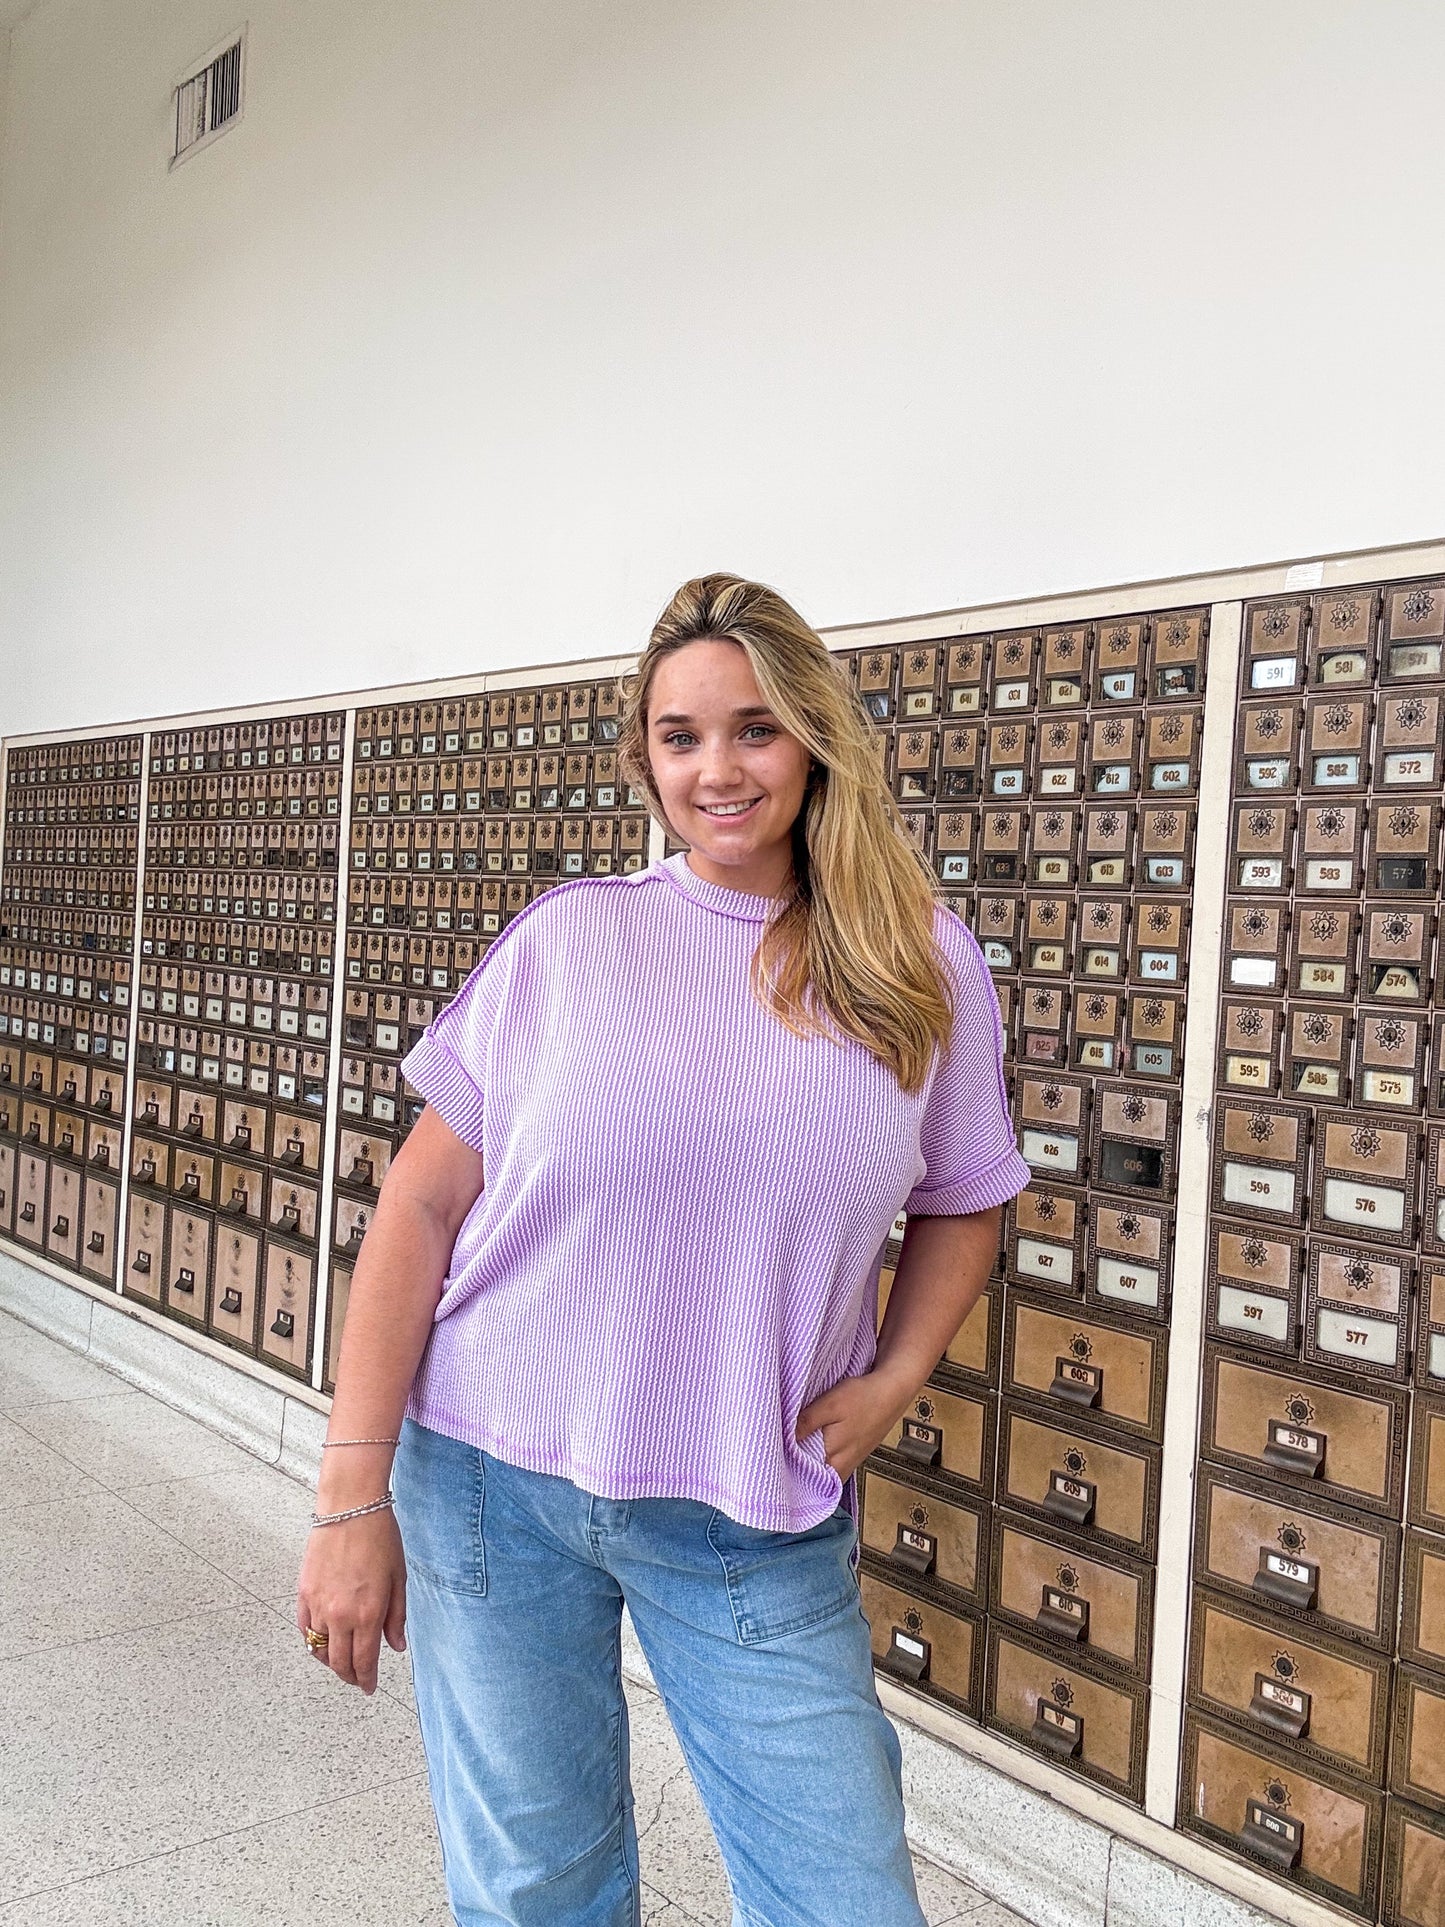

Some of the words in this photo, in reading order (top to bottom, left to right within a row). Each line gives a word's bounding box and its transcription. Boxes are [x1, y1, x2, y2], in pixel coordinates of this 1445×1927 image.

[1266, 667, 1284, 679] 591
[1335, 661, 1353, 673] 581
[1113, 680, 1125, 692] 611
[914, 698, 927, 708] 651
[1258, 767, 1277, 780] 592
[1399, 760, 1421, 774] 572
[1001, 777, 1015, 787] 632
[1051, 774, 1067, 785] 622
[1105, 773, 1120, 784] 612
[1162, 770, 1181, 782] 602
[948, 863, 963, 873] 643
[1100, 864, 1115, 875] 613
[1155, 866, 1174, 877] 603
[1251, 866, 1271, 878] 593
[1319, 867, 1341, 880] 583
[1040, 951, 1056, 963] 624
[1094, 956, 1109, 967] 614
[1149, 960, 1169, 972] 604
[1312, 969, 1335, 983] 584
[1385, 973, 1407, 987] 574
[1035, 1040, 1051, 1051] 625
[1089, 1046, 1104, 1058] 615
[1144, 1053, 1163, 1065] 605
[1239, 1064, 1259, 1078] 595
[1306, 1072, 1328, 1086] 585
[1379, 1080, 1401, 1095] 575
[1043, 1143, 1059, 1156] 626
[1123, 1158, 1143, 1172] 606
[1250, 1180, 1270, 1195] 596
[1355, 1198, 1376, 1213] 576
[1038, 1254, 1054, 1267] 627
[1119, 1276, 1138, 1289] 607
[1243, 1306, 1264, 1321] 597
[1346, 1329, 1368, 1345] 577
[1288, 1431, 1309, 1449] 578
[1063, 1481, 1081, 1497] 609
[910, 1532, 925, 1548] 640
[1278, 1559, 1299, 1577] 579
[1058, 1597, 1073, 1612] 610
[1055, 1713, 1065, 1727] W
[1265, 1818, 1280, 1833] 600
